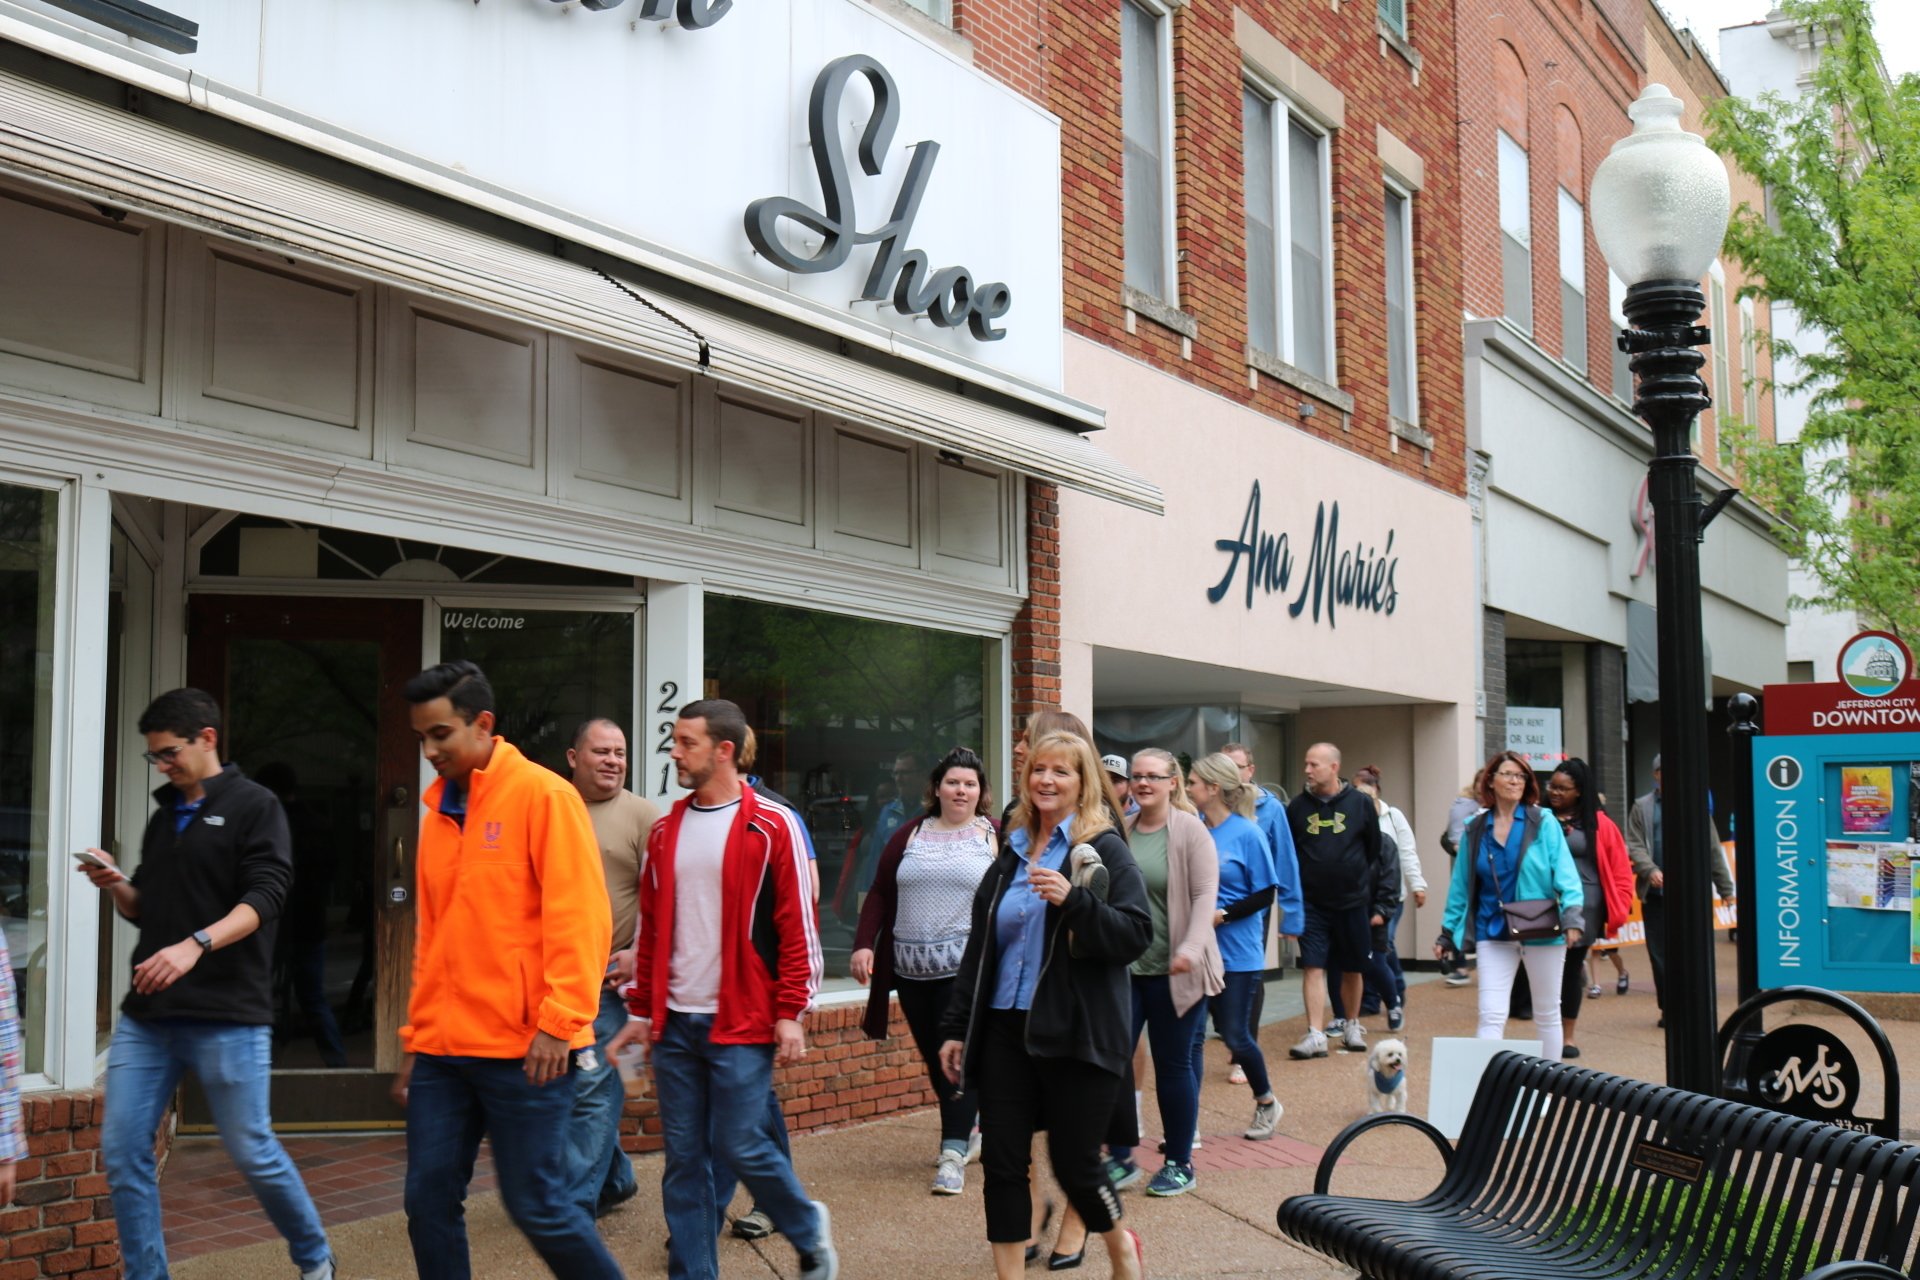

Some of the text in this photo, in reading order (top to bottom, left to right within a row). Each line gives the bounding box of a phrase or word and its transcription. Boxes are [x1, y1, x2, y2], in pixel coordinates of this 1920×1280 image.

[743, 54, 1011, 341] Shoe
[1206, 478, 1294, 611] Ana
[444, 612, 525, 629] Welcome
[1836, 698, 1916, 709] JEFFERSON CITY
[1508, 718, 1544, 727] FOR RENT
[1509, 734, 1545, 745] OR SALE
[1775, 800, 1801, 967] INFORMATION
